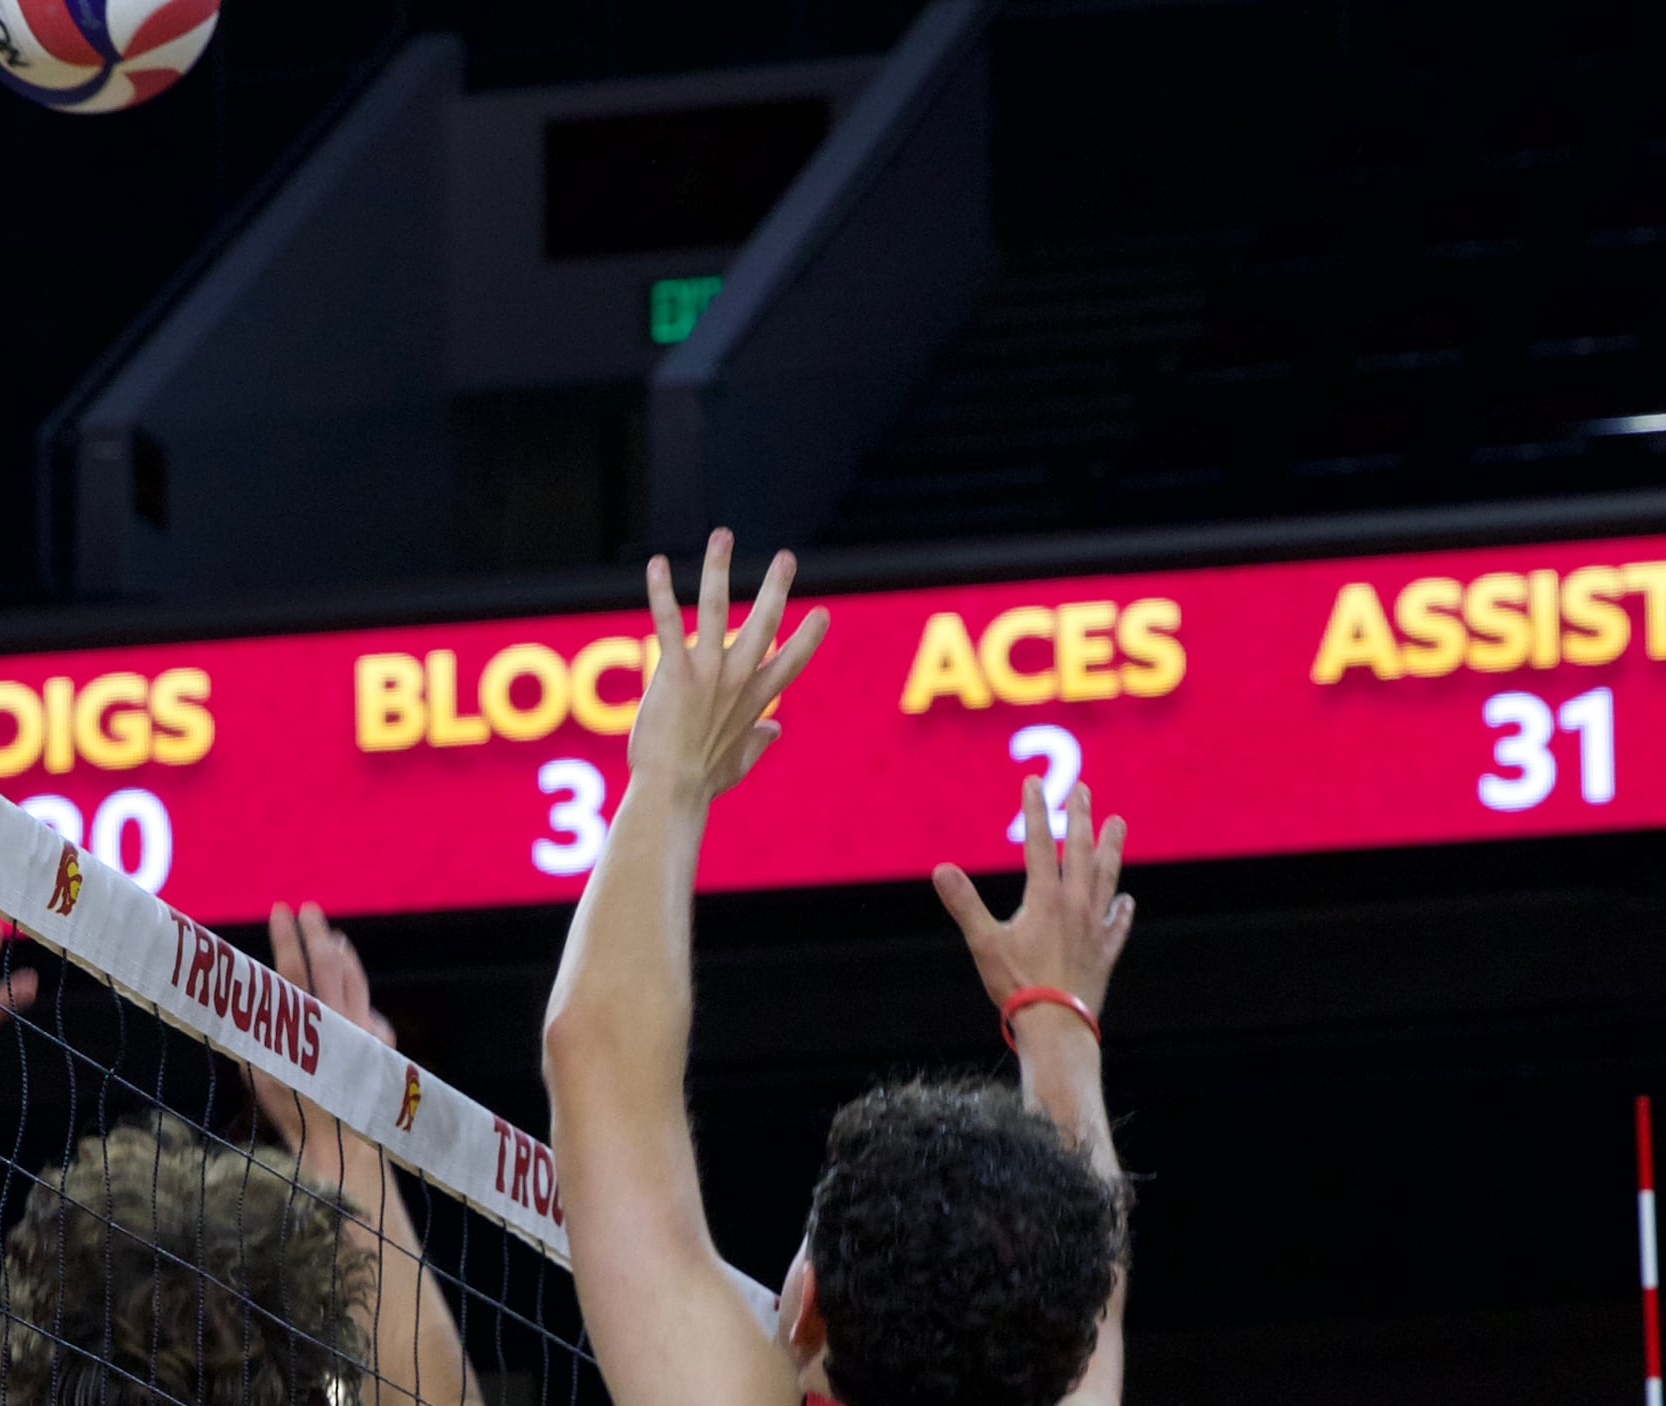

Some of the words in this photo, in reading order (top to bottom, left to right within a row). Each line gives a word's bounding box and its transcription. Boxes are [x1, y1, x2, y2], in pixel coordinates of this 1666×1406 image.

[354, 630, 781, 752] BLOC
[902, 598, 1187, 714] ACES
[1477, 686, 1615, 812] 31
[532, 756, 607, 877] 3
[171, 912, 322, 1076] TROJANS
